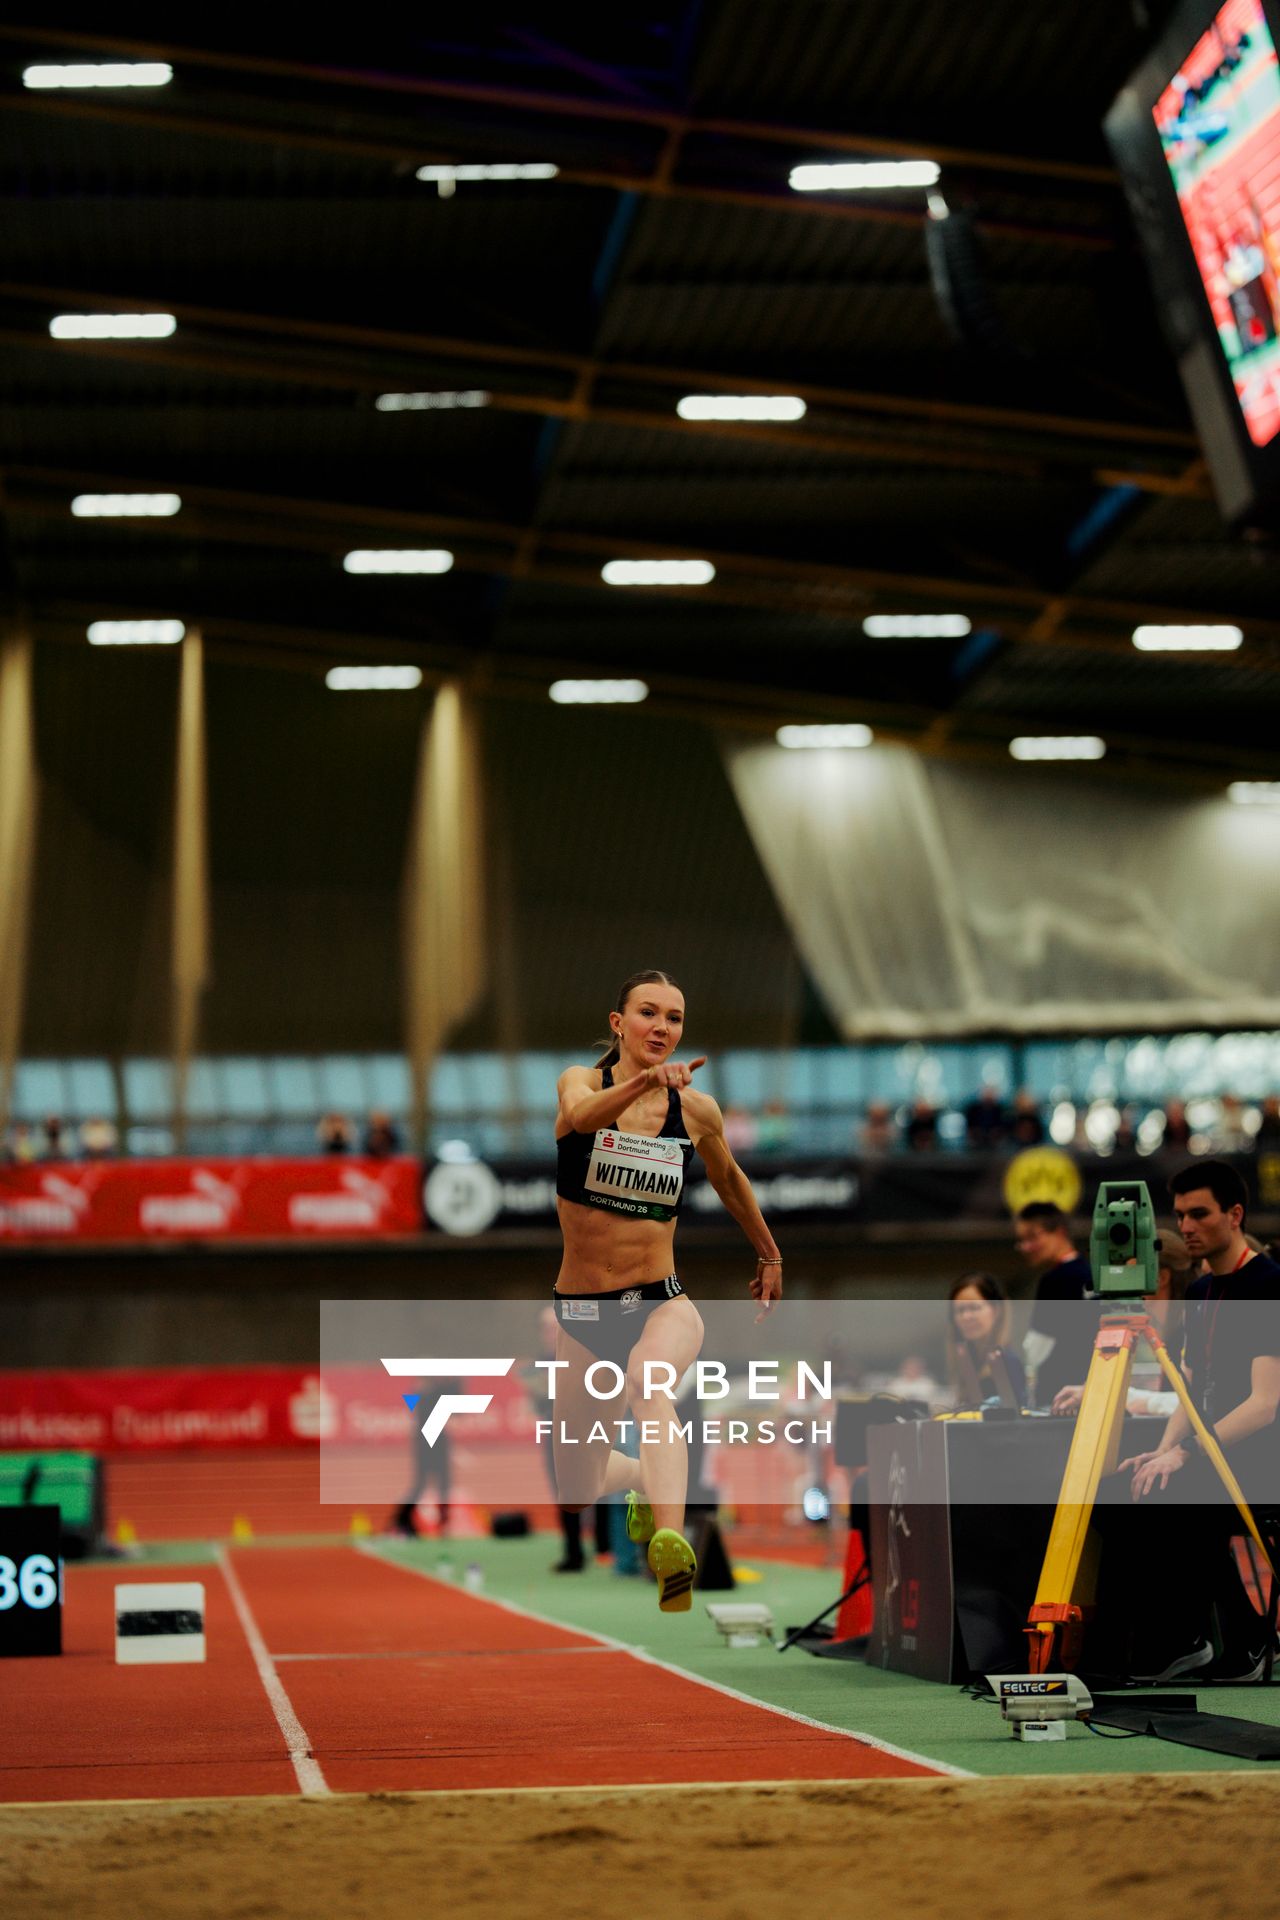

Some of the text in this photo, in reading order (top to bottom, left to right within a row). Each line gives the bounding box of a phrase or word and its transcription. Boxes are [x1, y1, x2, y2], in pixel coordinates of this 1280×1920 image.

[617, 1143, 650, 1155] Dortmund
[619, 1135, 667, 1151] Indoor Meeting
[595, 1162, 679, 1196] WITTMANN
[590, 1195, 648, 1213] DORTMUND 26
[1003, 1682, 1046, 1693] SELTEC
